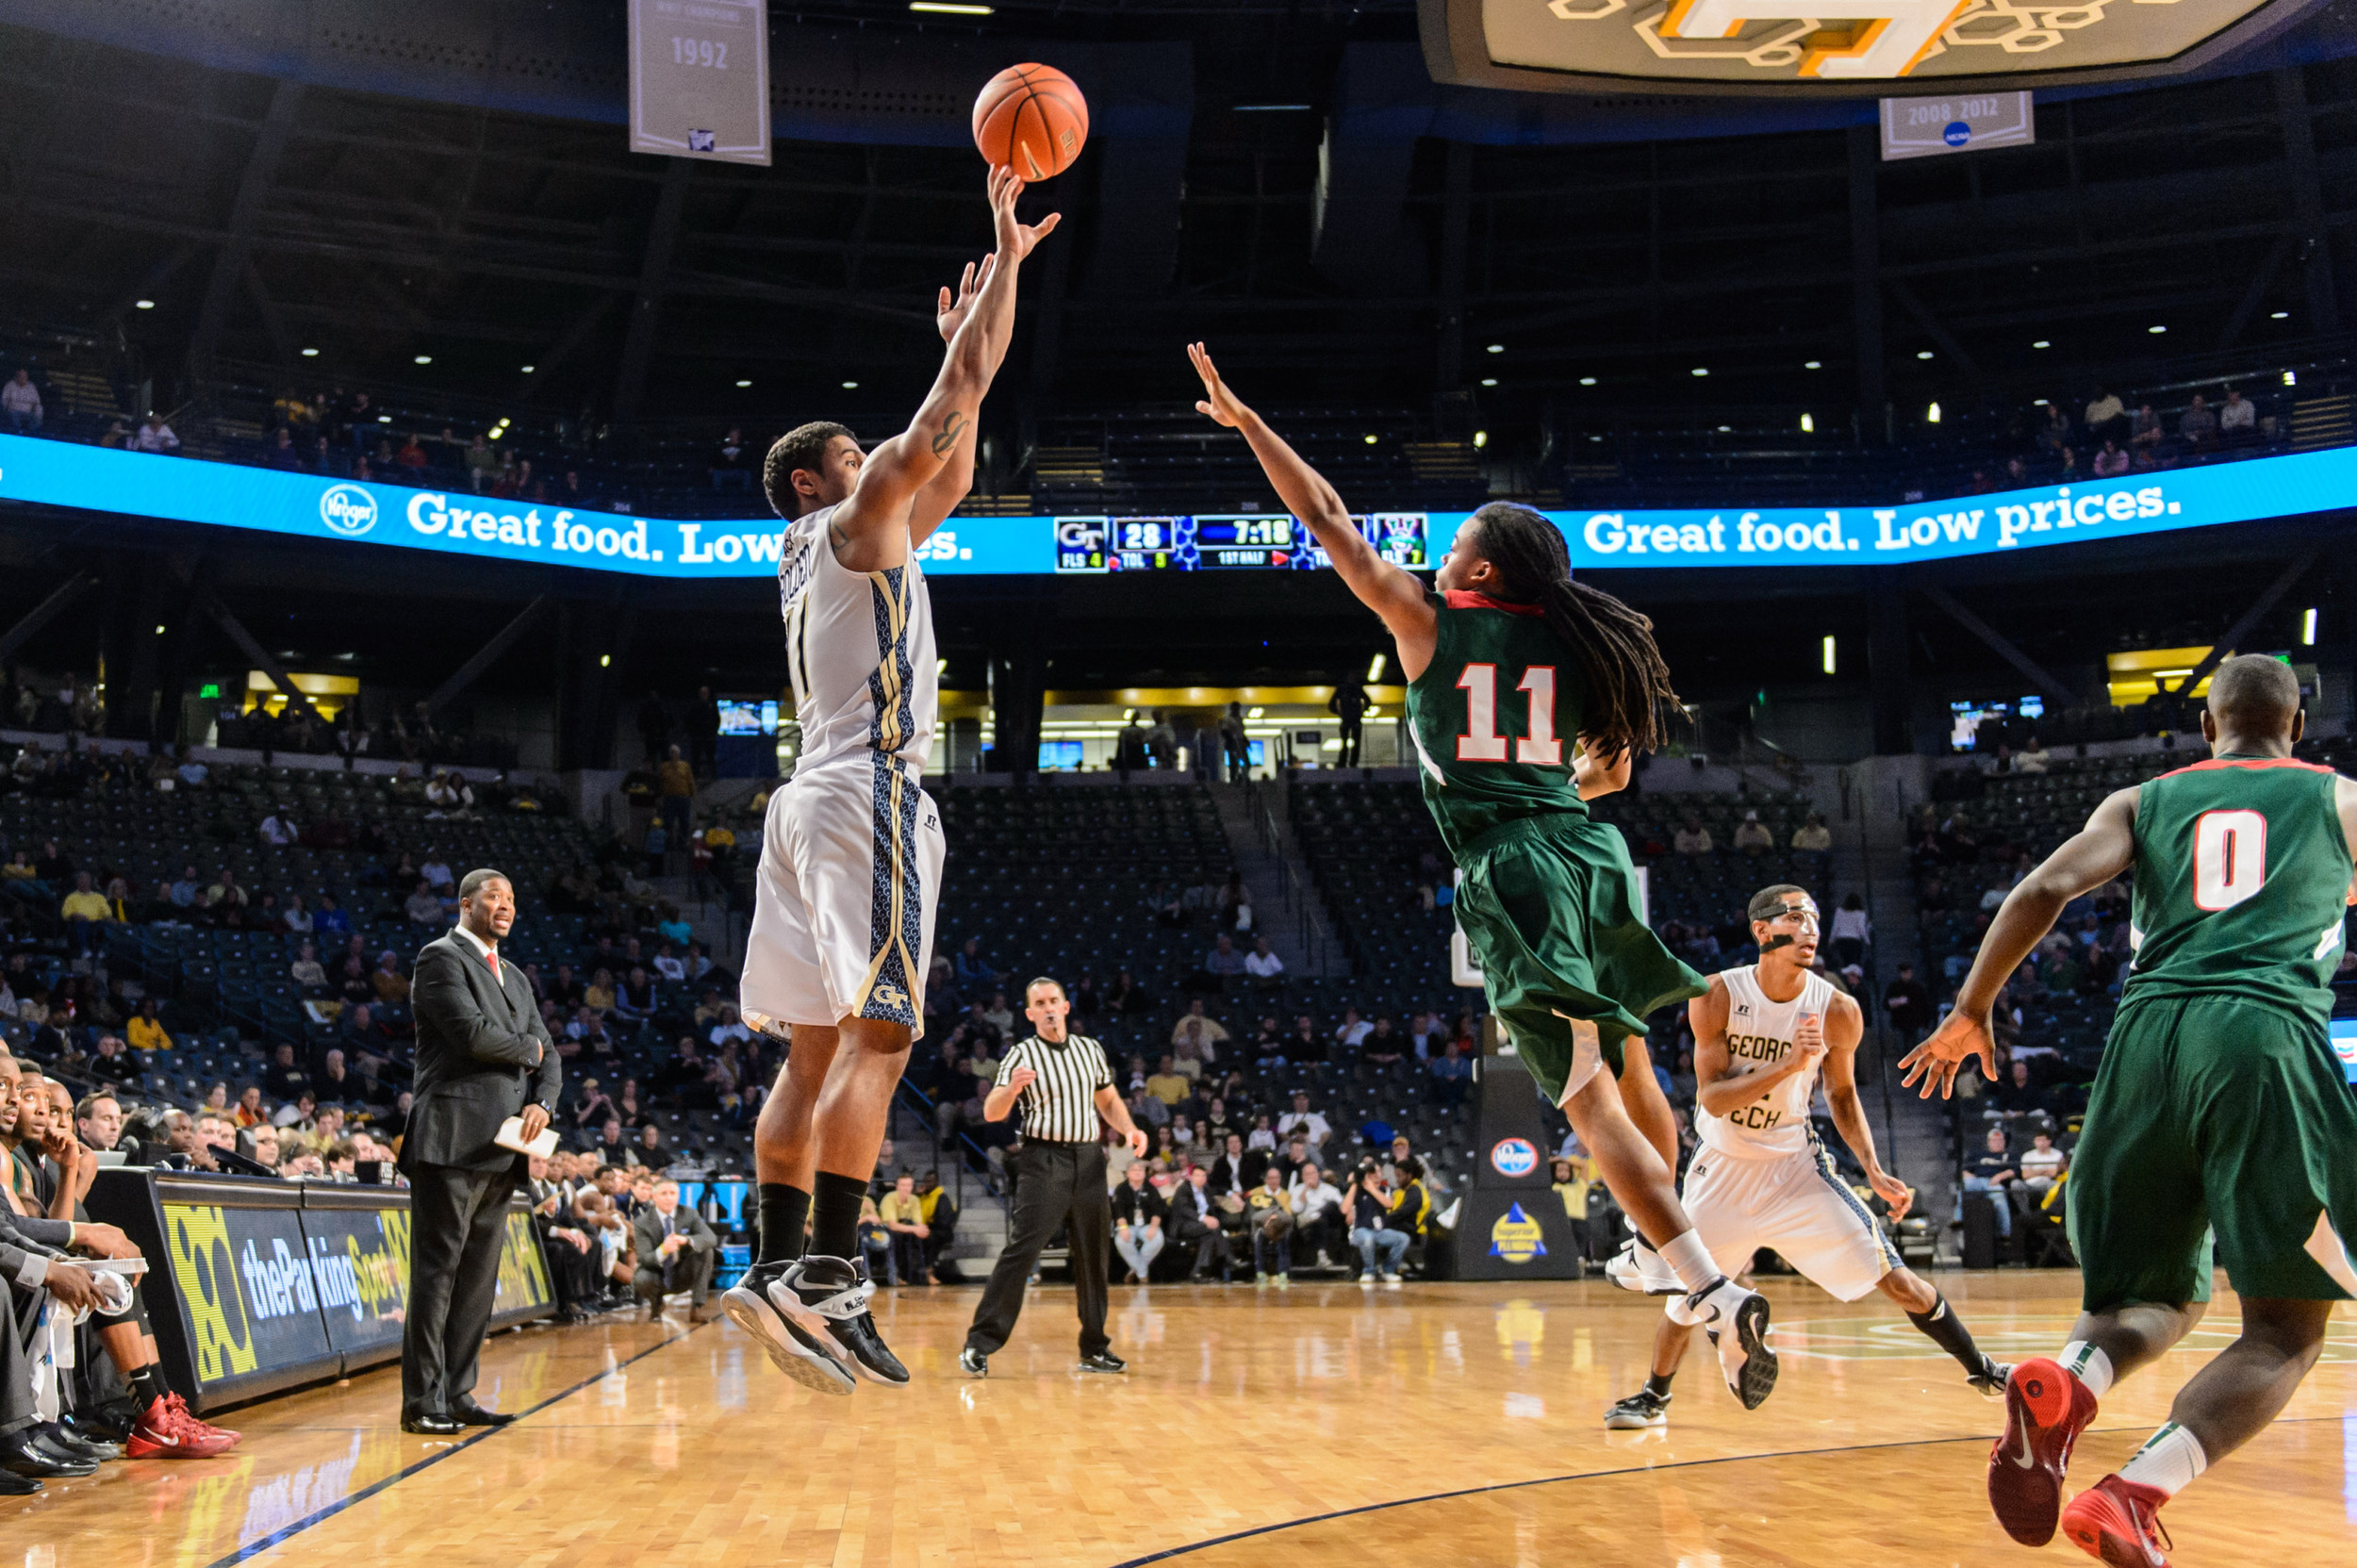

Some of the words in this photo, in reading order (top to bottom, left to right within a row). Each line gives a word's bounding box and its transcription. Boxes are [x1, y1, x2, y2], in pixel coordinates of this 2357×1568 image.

[671, 37, 728, 70] 1992
[1908, 103, 1952, 125] 2008
[1960, 98, 1998, 120] 2012
[328, 492, 371, 528] Kroger
[1583, 514, 1726, 553] Great
[1737, 511, 1860, 552] food.
[1872, 509, 1985, 551] Low
[1995, 487, 2182, 548] prices.
[406, 492, 541, 547] Great
[552, 510, 664, 562] food.
[1059, 522, 1104, 551] GT
[1126, 522, 1162, 550] 28
[1233, 520, 1291, 544] 7:18
[1062, 553, 1086, 568] FLS
[1089, 552, 1101, 568] 4
[1218, 551, 1237, 565] 1ST
[1239, 551, 1265, 565] HALF
[1455, 662, 1562, 765] 11
[2193, 808, 2266, 911] 0
[873, 984, 908, 1010] GT
[1730, 1106, 1782, 1130] ECH
